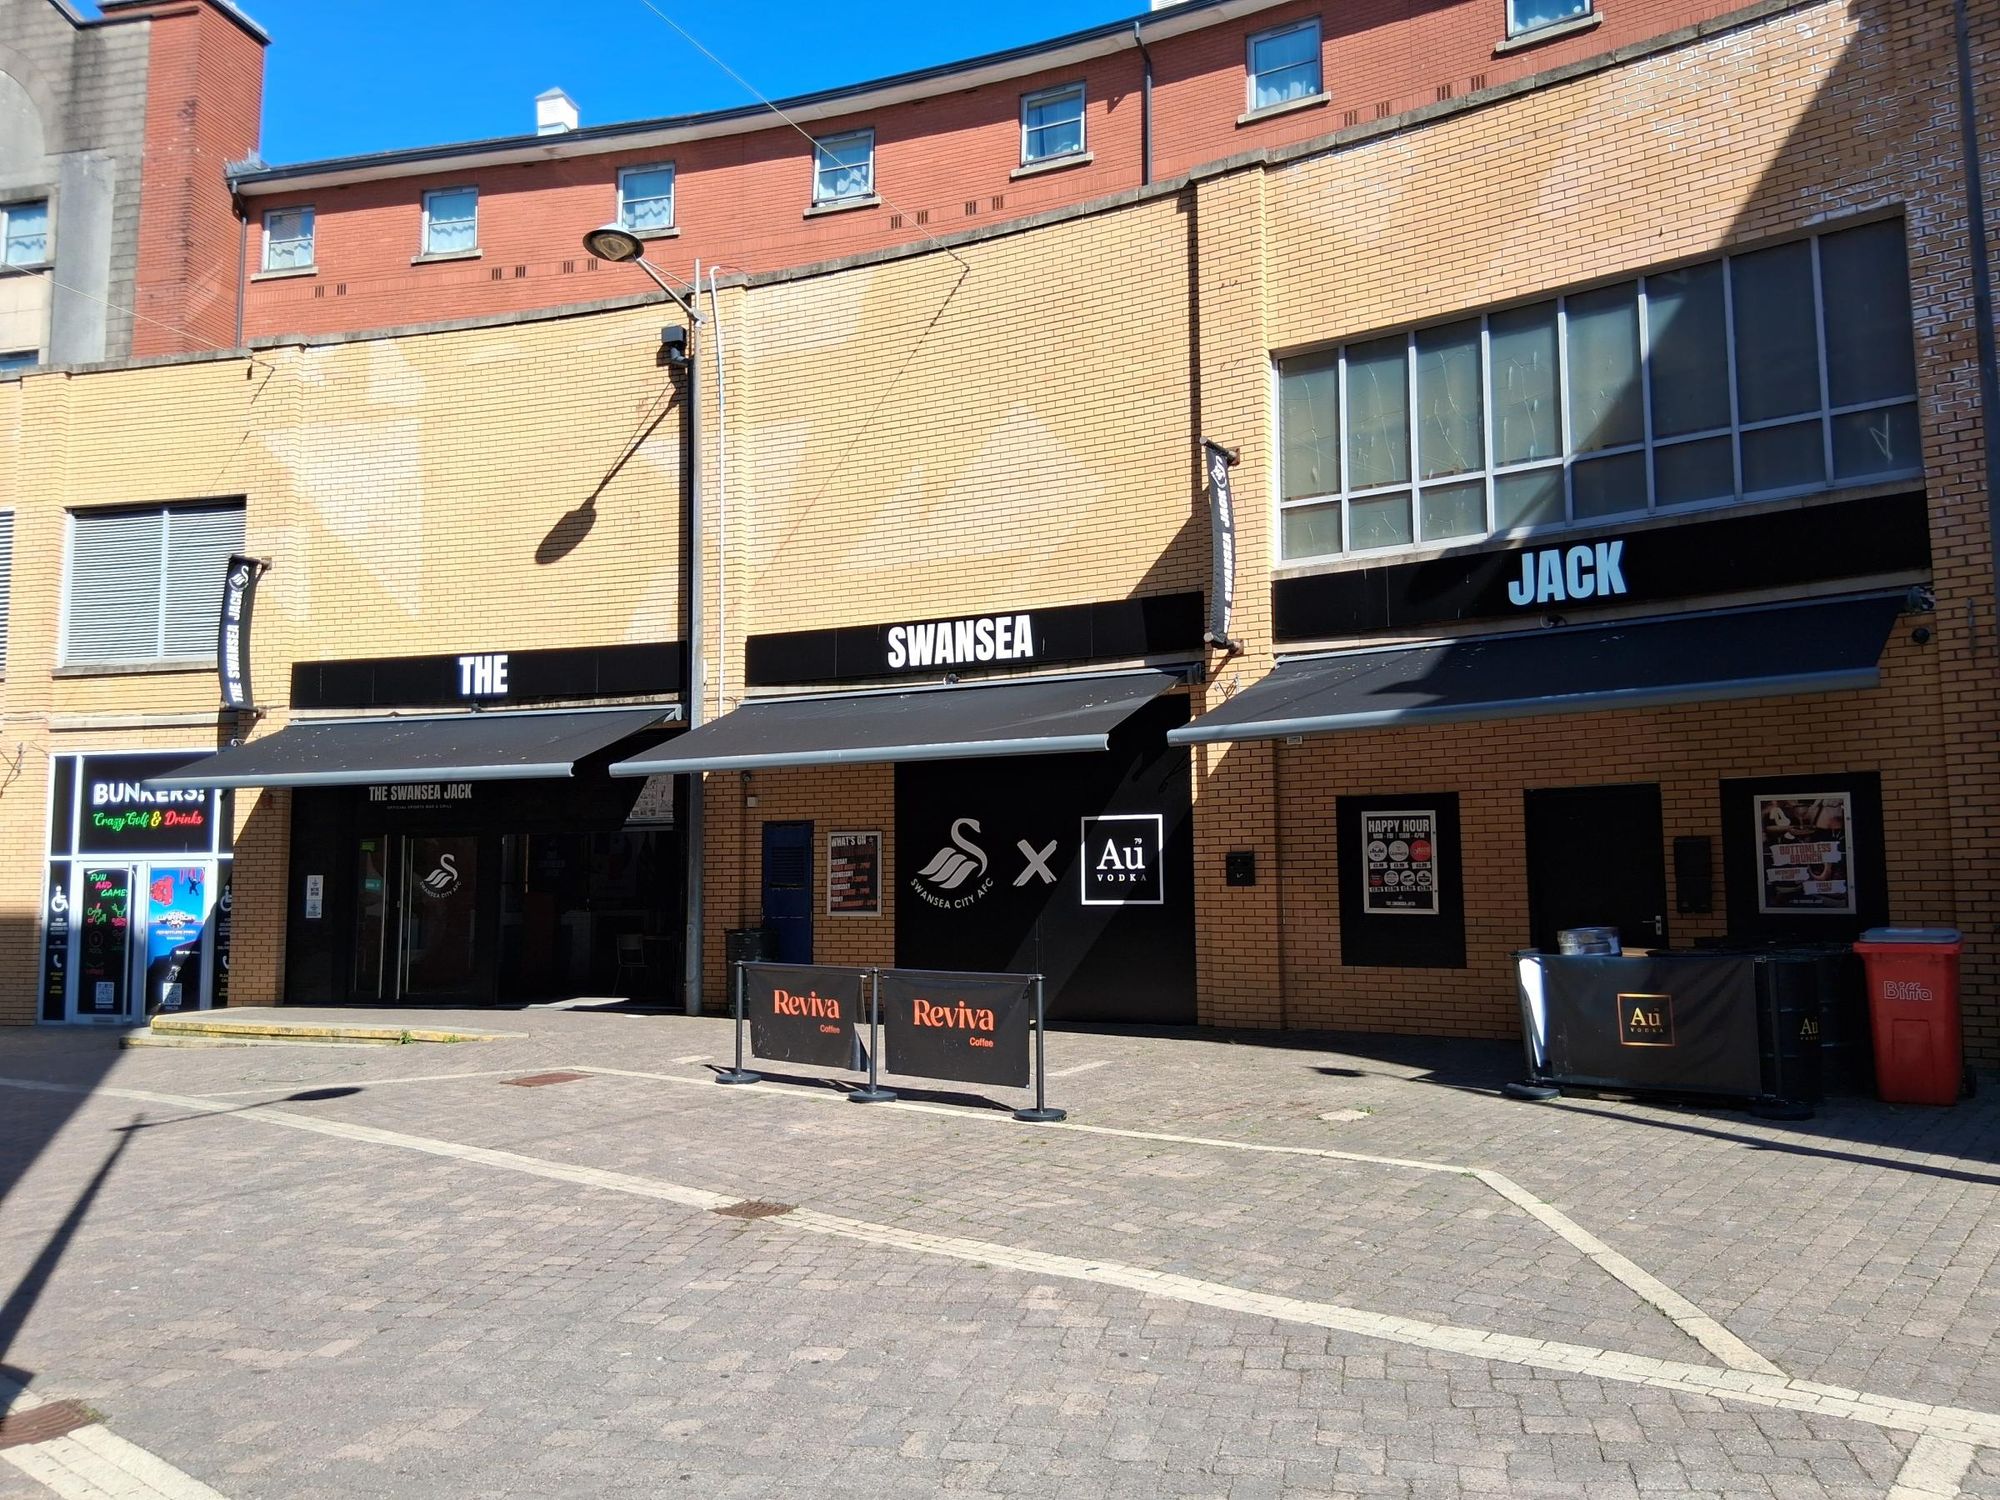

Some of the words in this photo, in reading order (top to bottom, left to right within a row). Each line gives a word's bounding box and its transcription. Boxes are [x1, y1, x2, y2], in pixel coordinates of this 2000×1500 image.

[1217, 488, 1230, 528] JACK
[1222, 532, 1232, 602] SWANSEA
[1508, 540, 1626, 606] JACK
[228, 590, 244, 620] JACK
[226, 624, 240, 679] SWANSEA
[888, 614, 1034, 669] SWANSEA
[458, 654, 508, 694] THE
[229, 682, 244, 702] THE
[368, 786, 388, 801] THE
[390, 784, 441, 800] SWANSEA
[444, 783, 472, 800] JACK
[93, 812, 126, 831] Crazy
[126, 812, 150, 827] Golf
[150, 811, 162, 827] &
[164, 810, 204, 826] Drinks
[1368, 820, 1400, 832] HAPPY
[1402, 819, 1429, 832] HOUR
[832, 836, 856, 847] WHAT'S
[856, 835, 866, 845] ON
[1780, 843, 1831, 855] BOTTOMLESS
[1096, 838, 1146, 870] Au
[1791, 854, 1822, 863] BRUNCH
[1097, 873, 1147, 882] VODKA
[420, 881, 440, 898] SWANSEA
[910, 878, 951, 910] SWANSEA
[954, 895, 975, 909] CITY
[978, 877, 994, 898] AFC
[1883, 981, 1933, 1001] Biffa
[774, 988, 840, 1020] Reviva
[913, 998, 994, 1032] Reviva
[1629, 1007, 1662, 1026] Au
[819, 1024, 841, 1034] Coffee
[969, 1036, 994, 1048] Coffee
